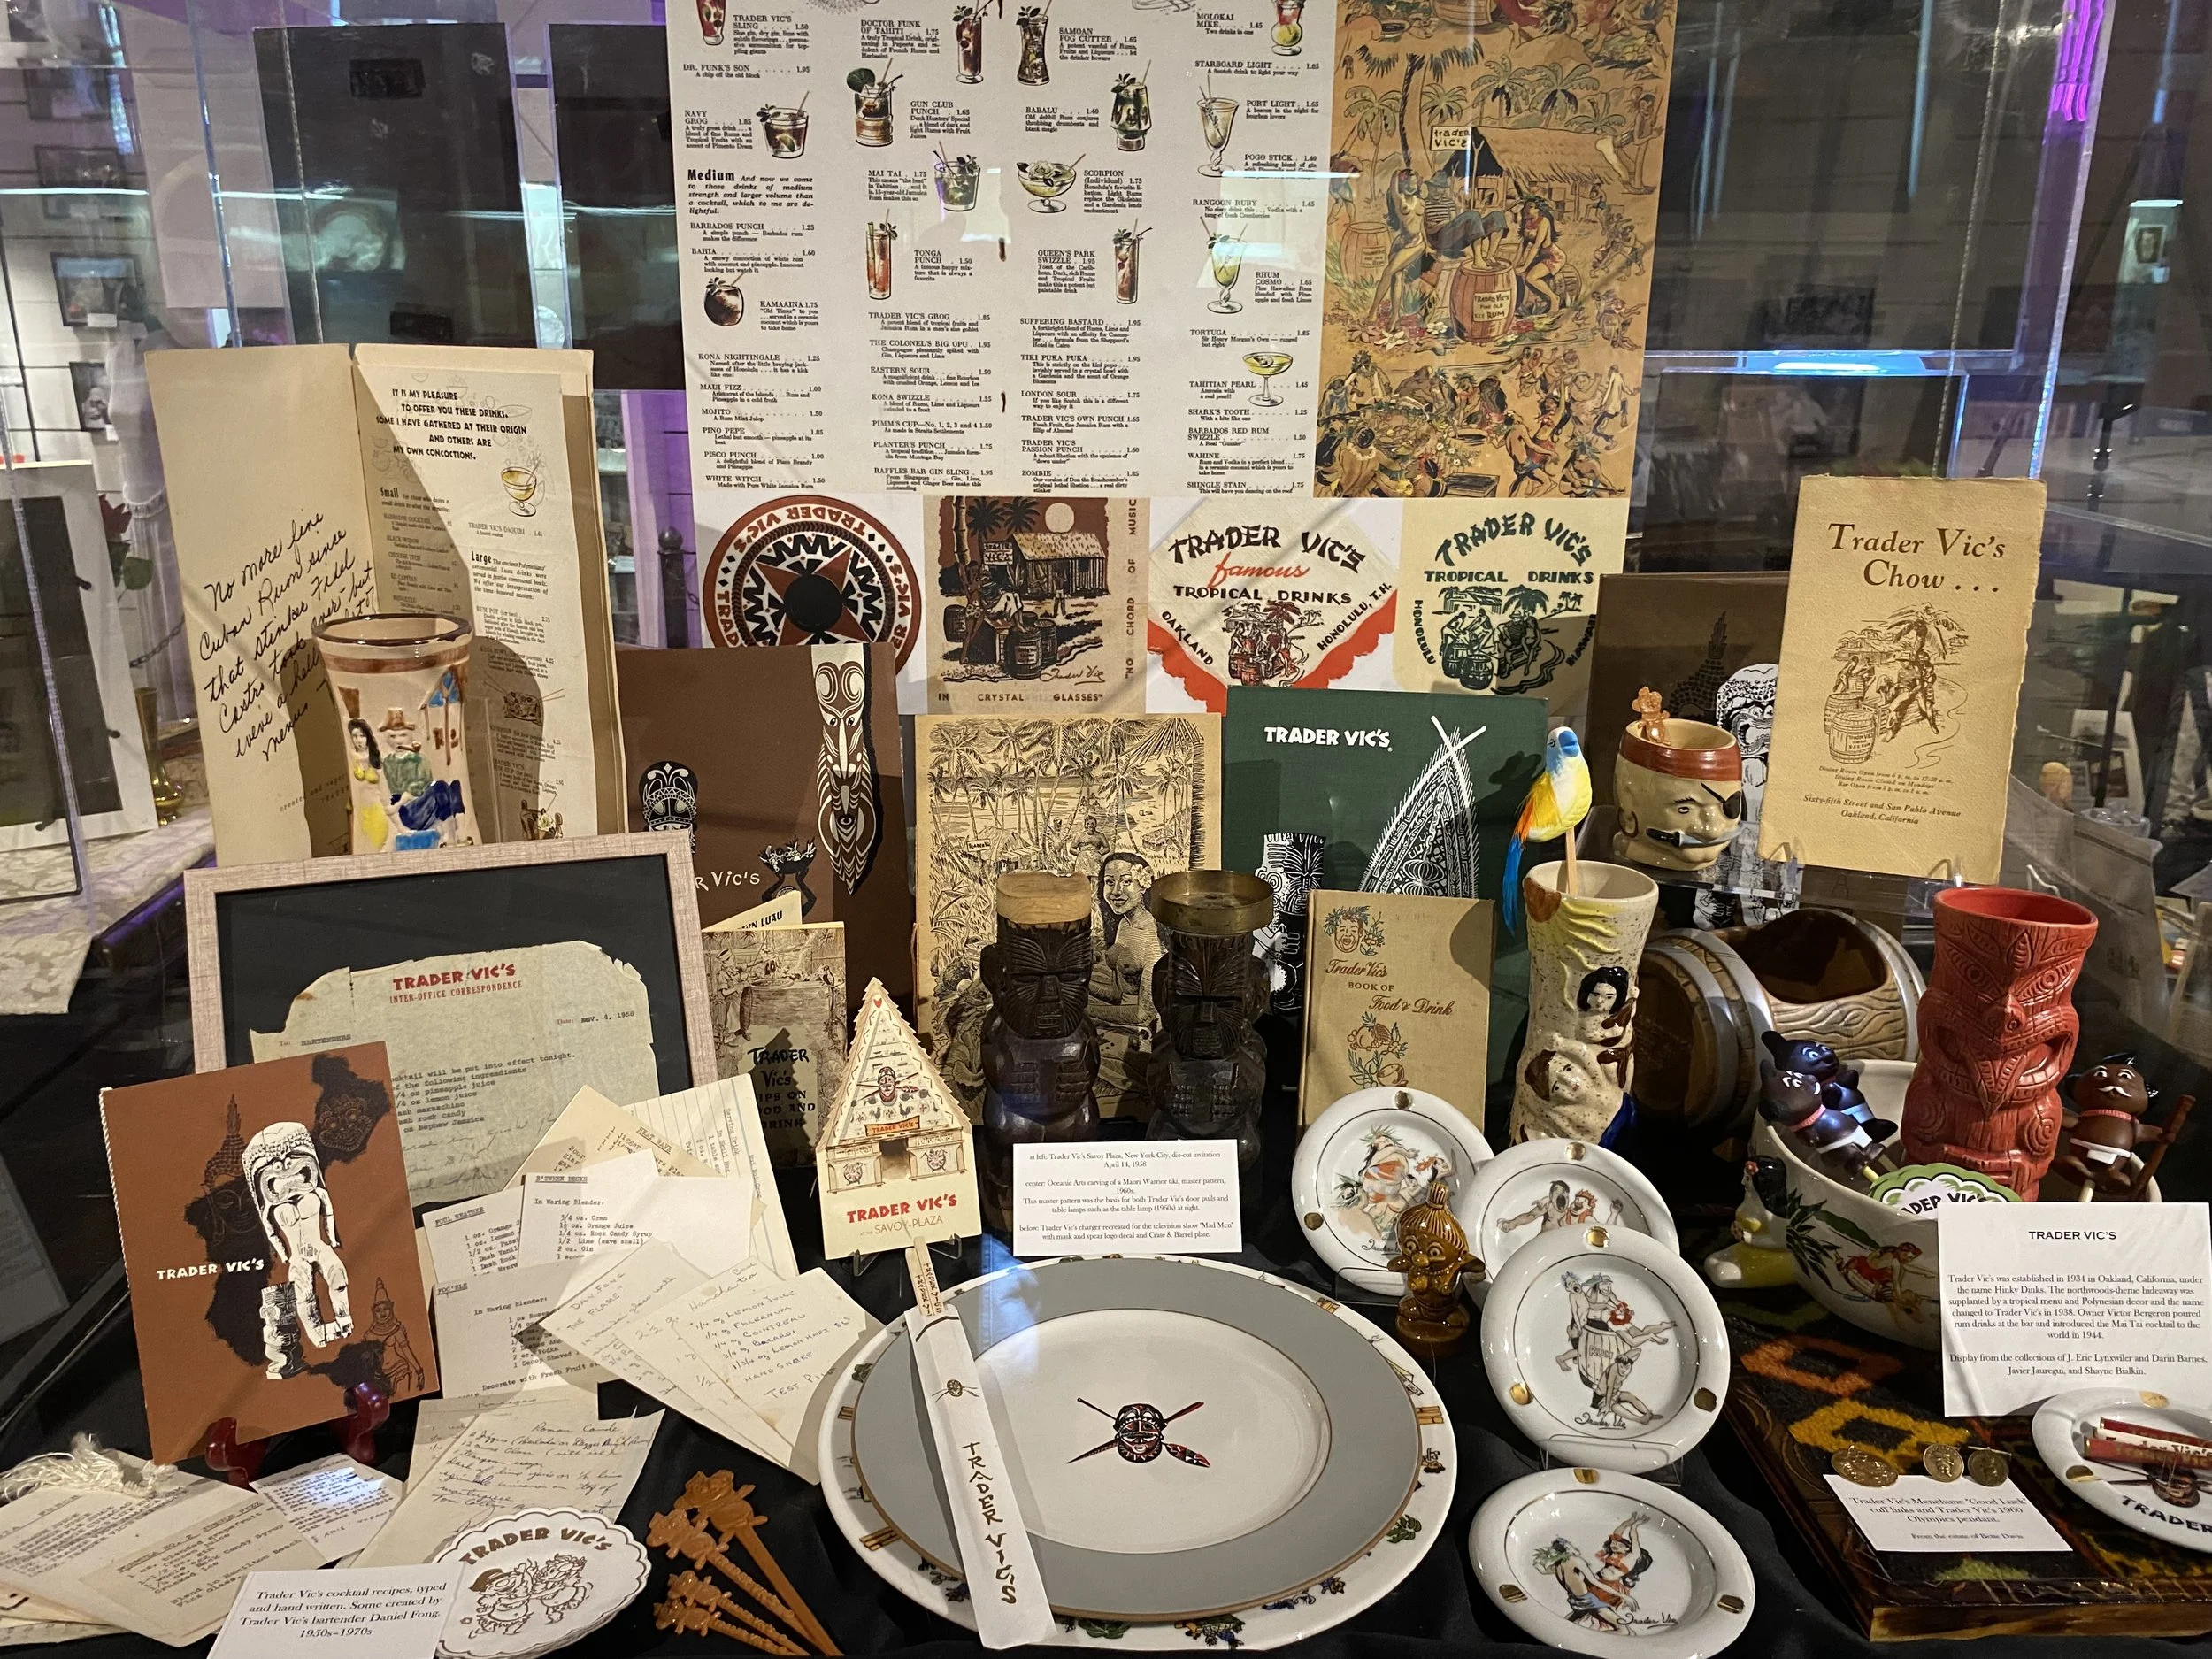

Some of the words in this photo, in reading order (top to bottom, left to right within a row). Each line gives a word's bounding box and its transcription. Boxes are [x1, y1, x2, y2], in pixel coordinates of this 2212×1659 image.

[733, 14, 768, 23] TRADER
[860, 19, 895, 28] DOCTOR
[1196, 12, 1234, 22] MOLOKAI
[1025, 106, 1057, 115] BABALU
[687, 168, 734, 181] Medium
[1019, 318, 1066, 326] SUFFERING
[1189, 328, 1227, 337] TORTUGA
[724, 353, 780, 362] NIGHTINGALE
[1020, 354, 1039, 363] TIKI
[1040, 354, 1063, 363] PUKA
[1065, 354, 1087, 363] PUKA
[400, 388, 407, 397] IS
[409, 389, 420, 398] MY
[422, 390, 458, 400] PLEASURE
[401, 403, 411, 412] TO
[412, 404, 435, 413] OFFER
[436, 405, 453, 414] YOU
[454, 406, 477, 416] THESE
[478, 408, 509, 419] DRINKS.
[1020, 414, 1053, 423] TRADER
[1097, 415, 1124, 424] PUNCH
[786, 506, 866, 536] TRADER
[733, 512, 781, 553] VIC'S
[1435, 512, 1535, 566] TRADER
[1544, 518, 1592, 566] VIC'S
[1827, 523, 1924, 554] Trader
[1936, 527, 2006, 558] Vic's
[1168, 524, 1281, 563] TRADER
[1301, 532, 1366, 573] VIC'S
[1129, 559, 1136, 573] OF
[1207, 552, 1310, 589] famous
[1863, 557, 1945, 589] Chow
[1424, 571, 1508, 582] TROPICAL
[1528, 571, 1594, 584] DRINKS
[888, 564, 910, 617] VIC'S
[1173, 586, 1262, 600] TROPICAL
[1278, 590, 1352, 605] DRINKS
[717, 590, 739, 647] TRAD
[1317, 602, 1372, 651] HONOLULU,
[1370, 582, 1392, 602] T.H.
[1162, 611, 1214, 665] OAKLAND
[1413, 599, 1436, 664] HONOLULU
[1264, 726, 1339, 746] TRADER
[1344, 728, 1392, 748] VIC'S
[1802, 795, 1841, 805] Sixty-fifth
[1842, 798, 1869, 808] Street
[1902, 804, 1927, 813] Pablo
[1928, 807, 1962, 817] Avenue
[1840, 809, 1877, 820] Oakland,
[1878, 813, 1919, 825] California
[761, 910, 782, 927] LUAU
[393, 971, 465, 991] TRADER
[470, 963, 517, 981] VIC'S
[1325, 959, 1366, 976] Trader
[1367, 962, 1387, 978] Vic's
[389, 988, 447, 1004] INTER-OFFICE
[450, 980, 523, 997] CORRESPONDENCE
[1348, 981, 1378, 991] BOOK
[1381, 983, 1394, 992] OF
[1369, 995, 1399, 1010] Food
[1402, 998, 1411, 1011] &
[1413, 998, 1455, 1016] Drink
[747, 1048, 809, 1066] TRADER
[761, 1070, 791, 1087] Vic's
[757, 1092, 780, 1102] IPS
[760, 1104, 782, 1115] OOD
[847, 1202, 910, 1224] TRADER
[917, 1193, 956, 1211] VIC'S
[1901, 1195, 1941, 1214] DER
[874, 1215, 943, 1233] SAVOY-PLAZA
[2028, 1231, 2080, 1240] TRADER
[2083, 1231, 2116, 1240] VIC'S
[157, 1263, 218, 1279] TRADER
[226, 1258, 264, 1272] VIC'S
[1947, 1274, 1975, 1283] Trader
[2011, 1273, 2055, 1282] established
[2097, 1274, 2134, 1284] Oakland,
[2135, 1274, 2177, 1284] California,
[2178, 1275, 2203, 1284] under
[961, 1441, 1004, 1525] TRADER
[984, 1532, 1017, 1604] VIC'S
[1907, 1515, 1955, 1524] Olympics
[2122, 1495, 2212, 1532] TRADER
[458, 1526, 549, 1565] TRADER
[561, 1527, 613, 1552] VIC'S
[257, 1590, 296, 1600] Trader
[299, 1589, 323, 1598] Vic's
[326, 1587, 370, 1597] cocktail
[371, 1587, 412, 1596] recipes,
[416, 1582, 447, 1594] typed
